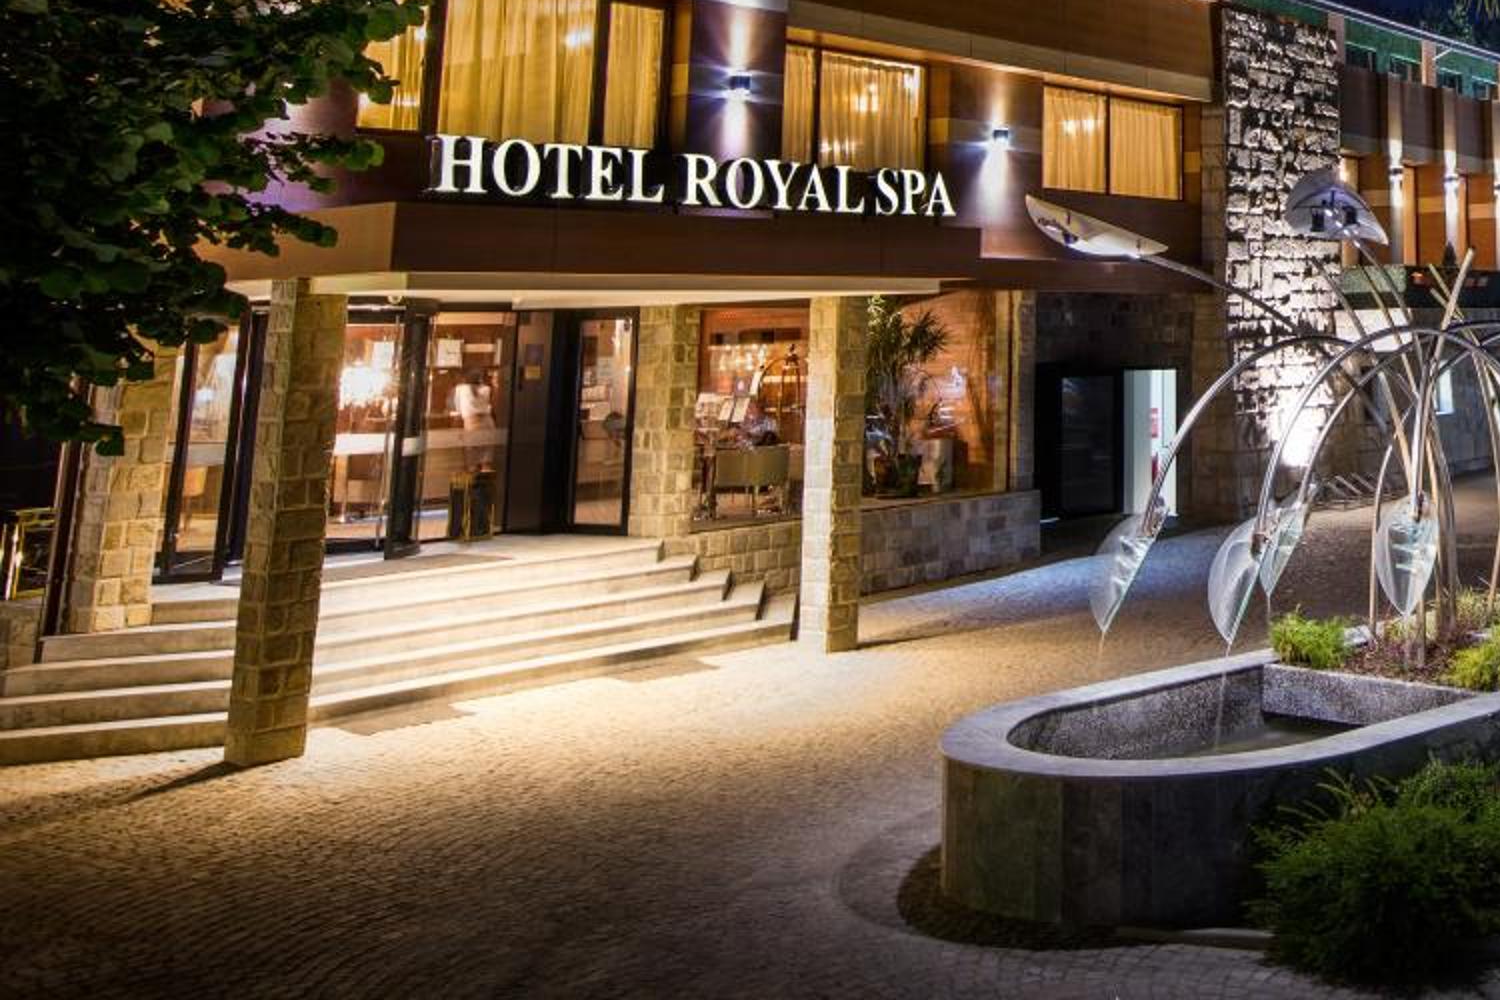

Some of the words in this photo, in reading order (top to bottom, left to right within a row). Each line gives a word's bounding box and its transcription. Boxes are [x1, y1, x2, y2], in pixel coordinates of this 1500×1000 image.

[433, 134, 664, 202] HOTEL
[681, 153, 865, 213] ROYAL
[875, 167, 957, 217] SPA
